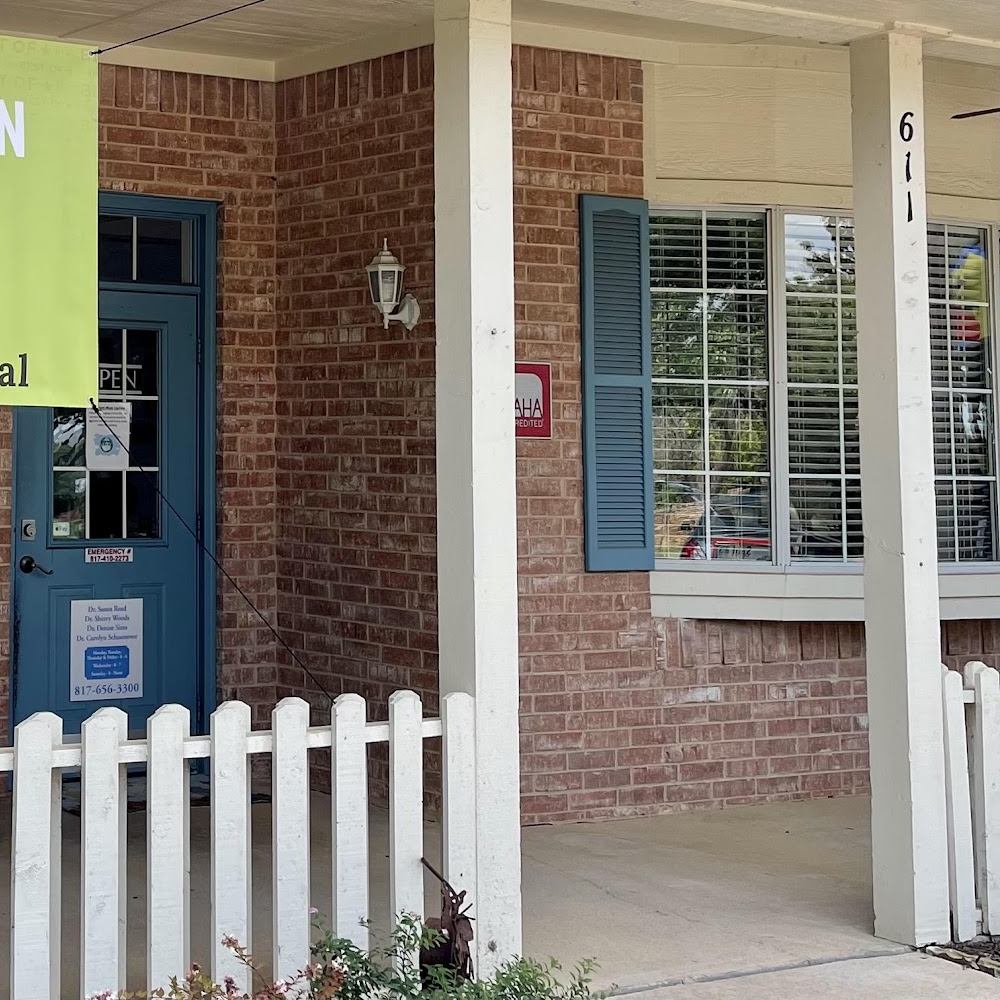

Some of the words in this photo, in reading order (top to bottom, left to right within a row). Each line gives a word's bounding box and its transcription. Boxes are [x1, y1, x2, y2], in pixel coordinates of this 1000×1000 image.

[898, 111, 915, 223] 611
[99, 368, 136, 389] PEN
[515, 397, 543, 418] AHA
[515, 420, 543, 428] REDITED
[74, 682, 140, 696] 817-656-3300
